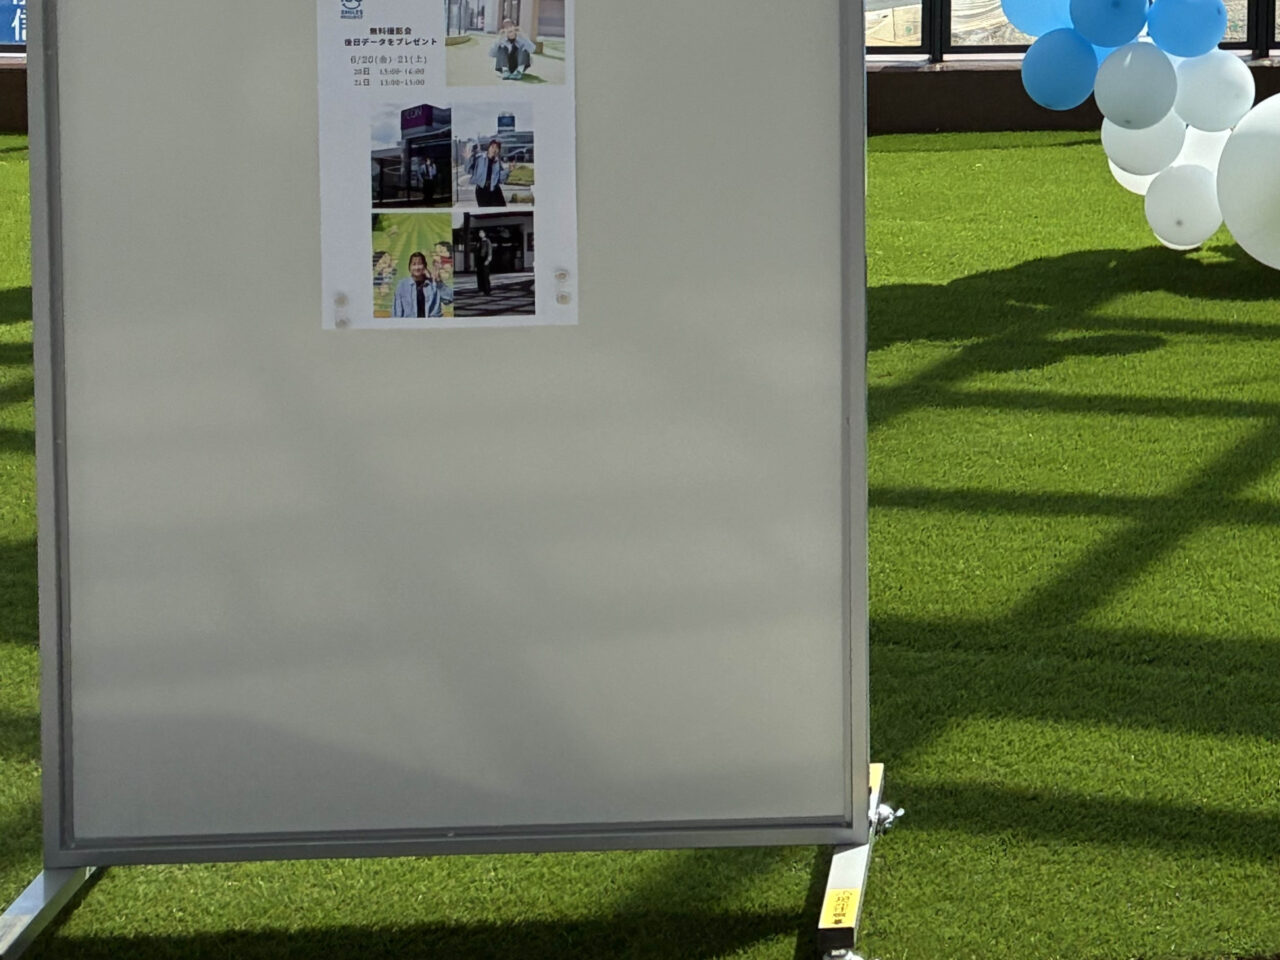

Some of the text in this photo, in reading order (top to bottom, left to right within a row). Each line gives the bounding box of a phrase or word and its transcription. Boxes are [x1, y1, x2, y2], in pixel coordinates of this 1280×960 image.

[344, 38, 438, 46] 後日データをプレゼント
